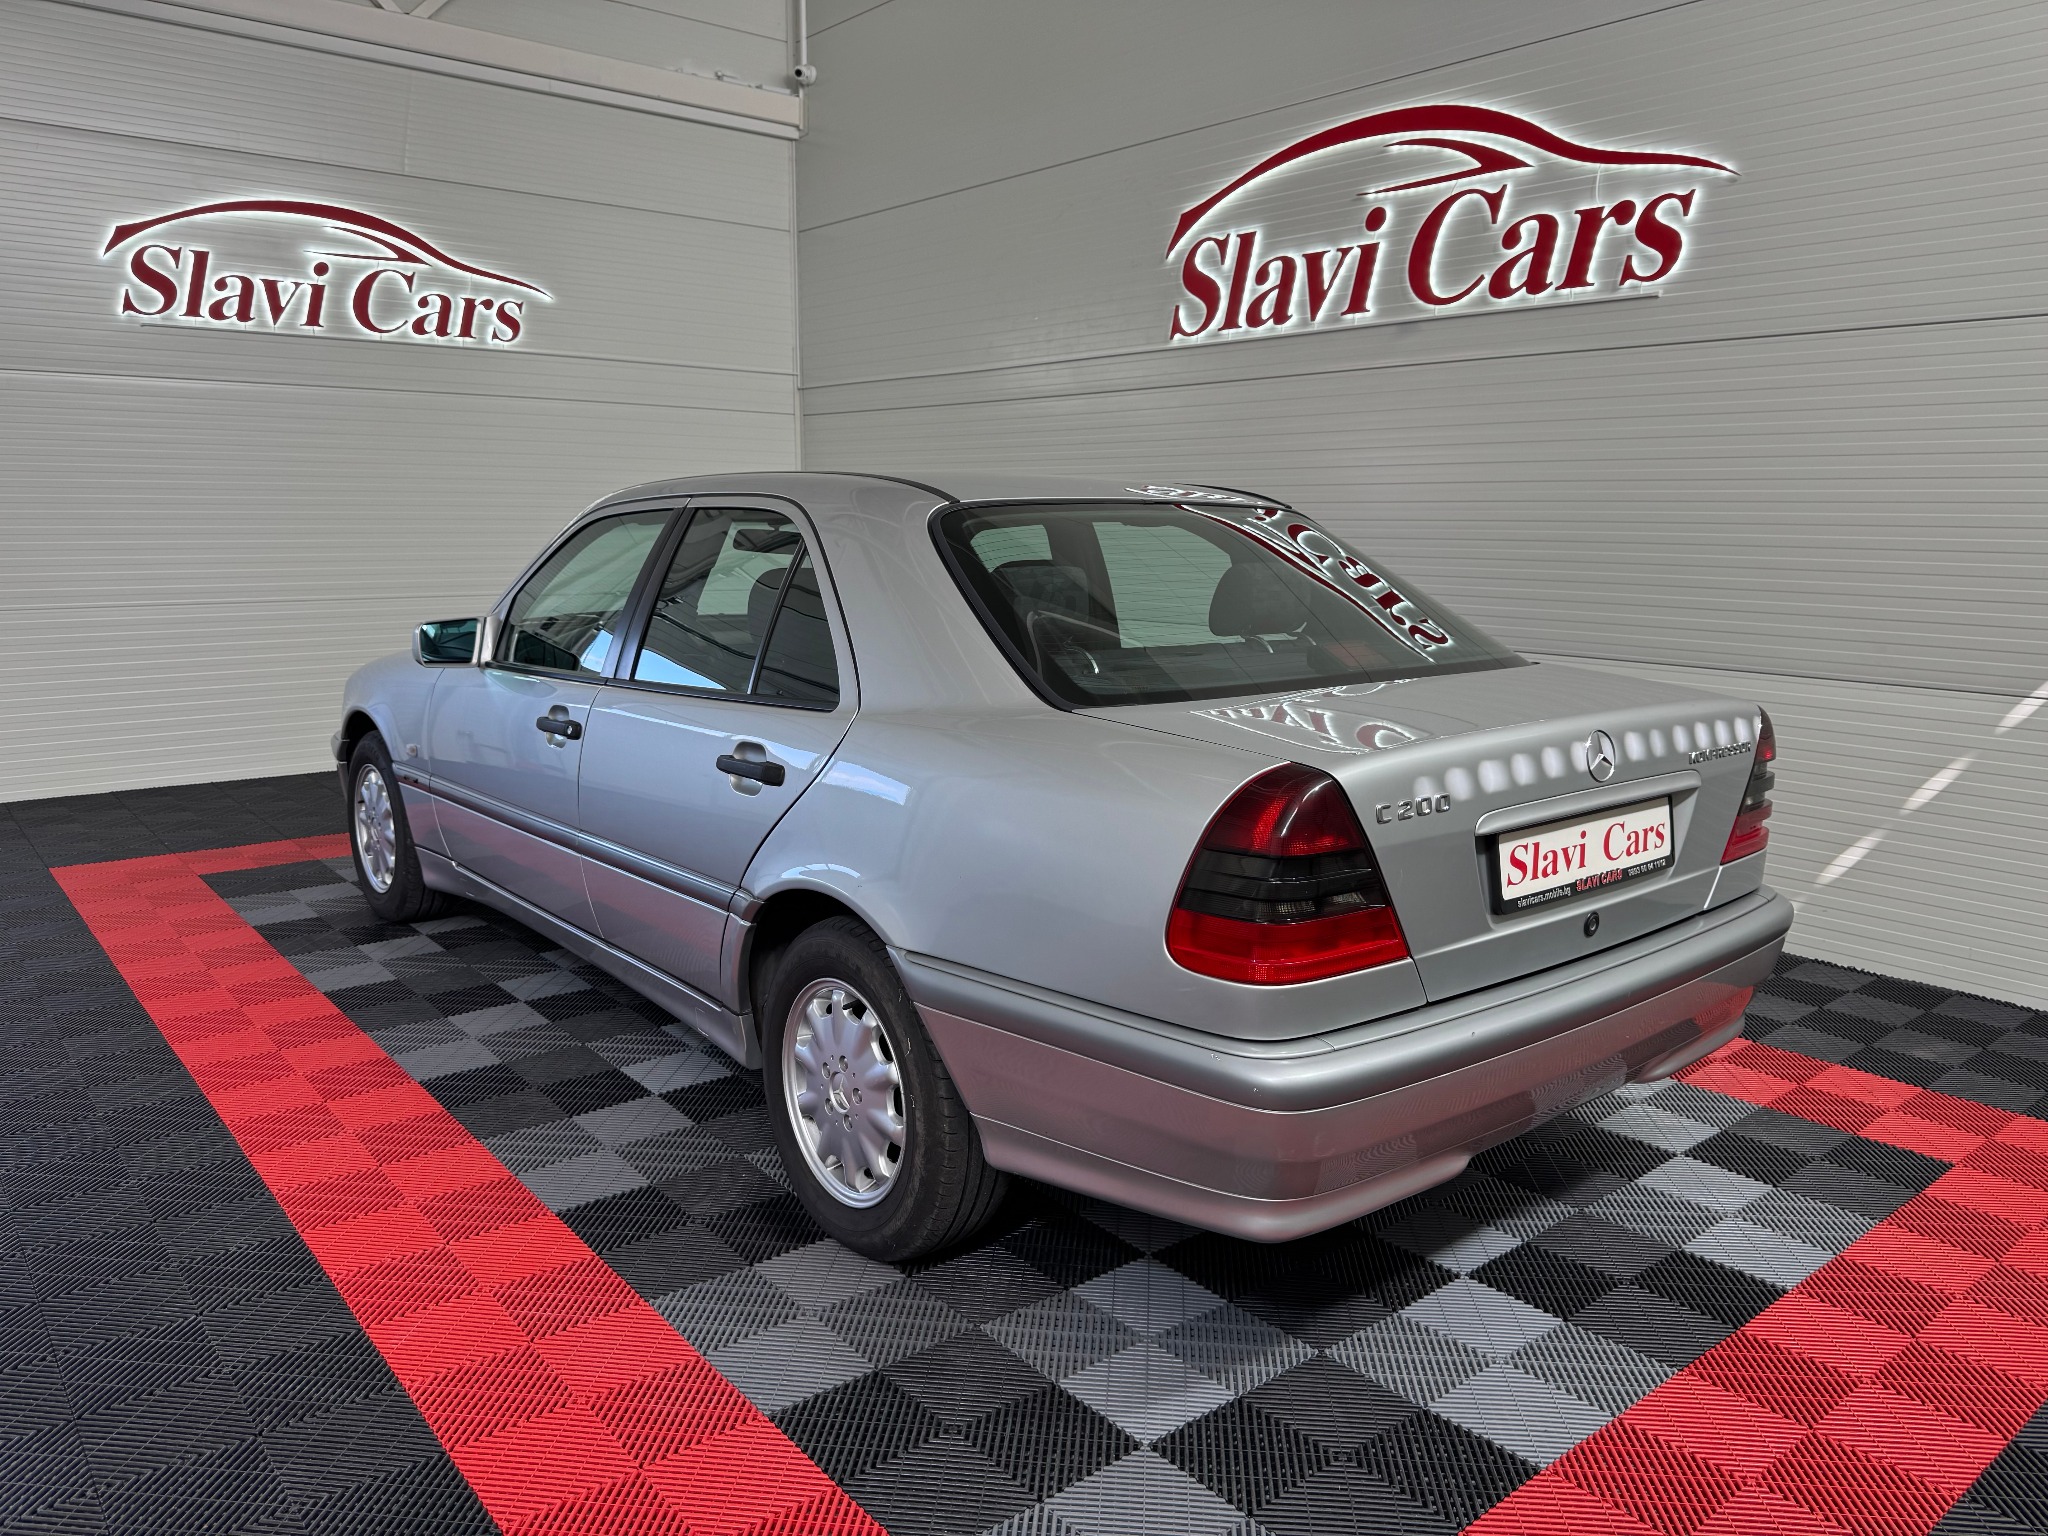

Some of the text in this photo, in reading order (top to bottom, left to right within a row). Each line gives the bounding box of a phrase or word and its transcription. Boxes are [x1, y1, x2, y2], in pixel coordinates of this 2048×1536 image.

[121, 243, 525, 343] Slavi Cars
[1169, 183, 1697, 341] Slavi Cars
[1375, 792, 1451, 825] C 200
[1506, 820, 1666, 888] Slavi Cars
[1517, 885, 1571, 908] slavicars.mobile.bg
[1576, 873, 1600, 892] SLAVI
[1601, 868, 1623, 885] CARS
